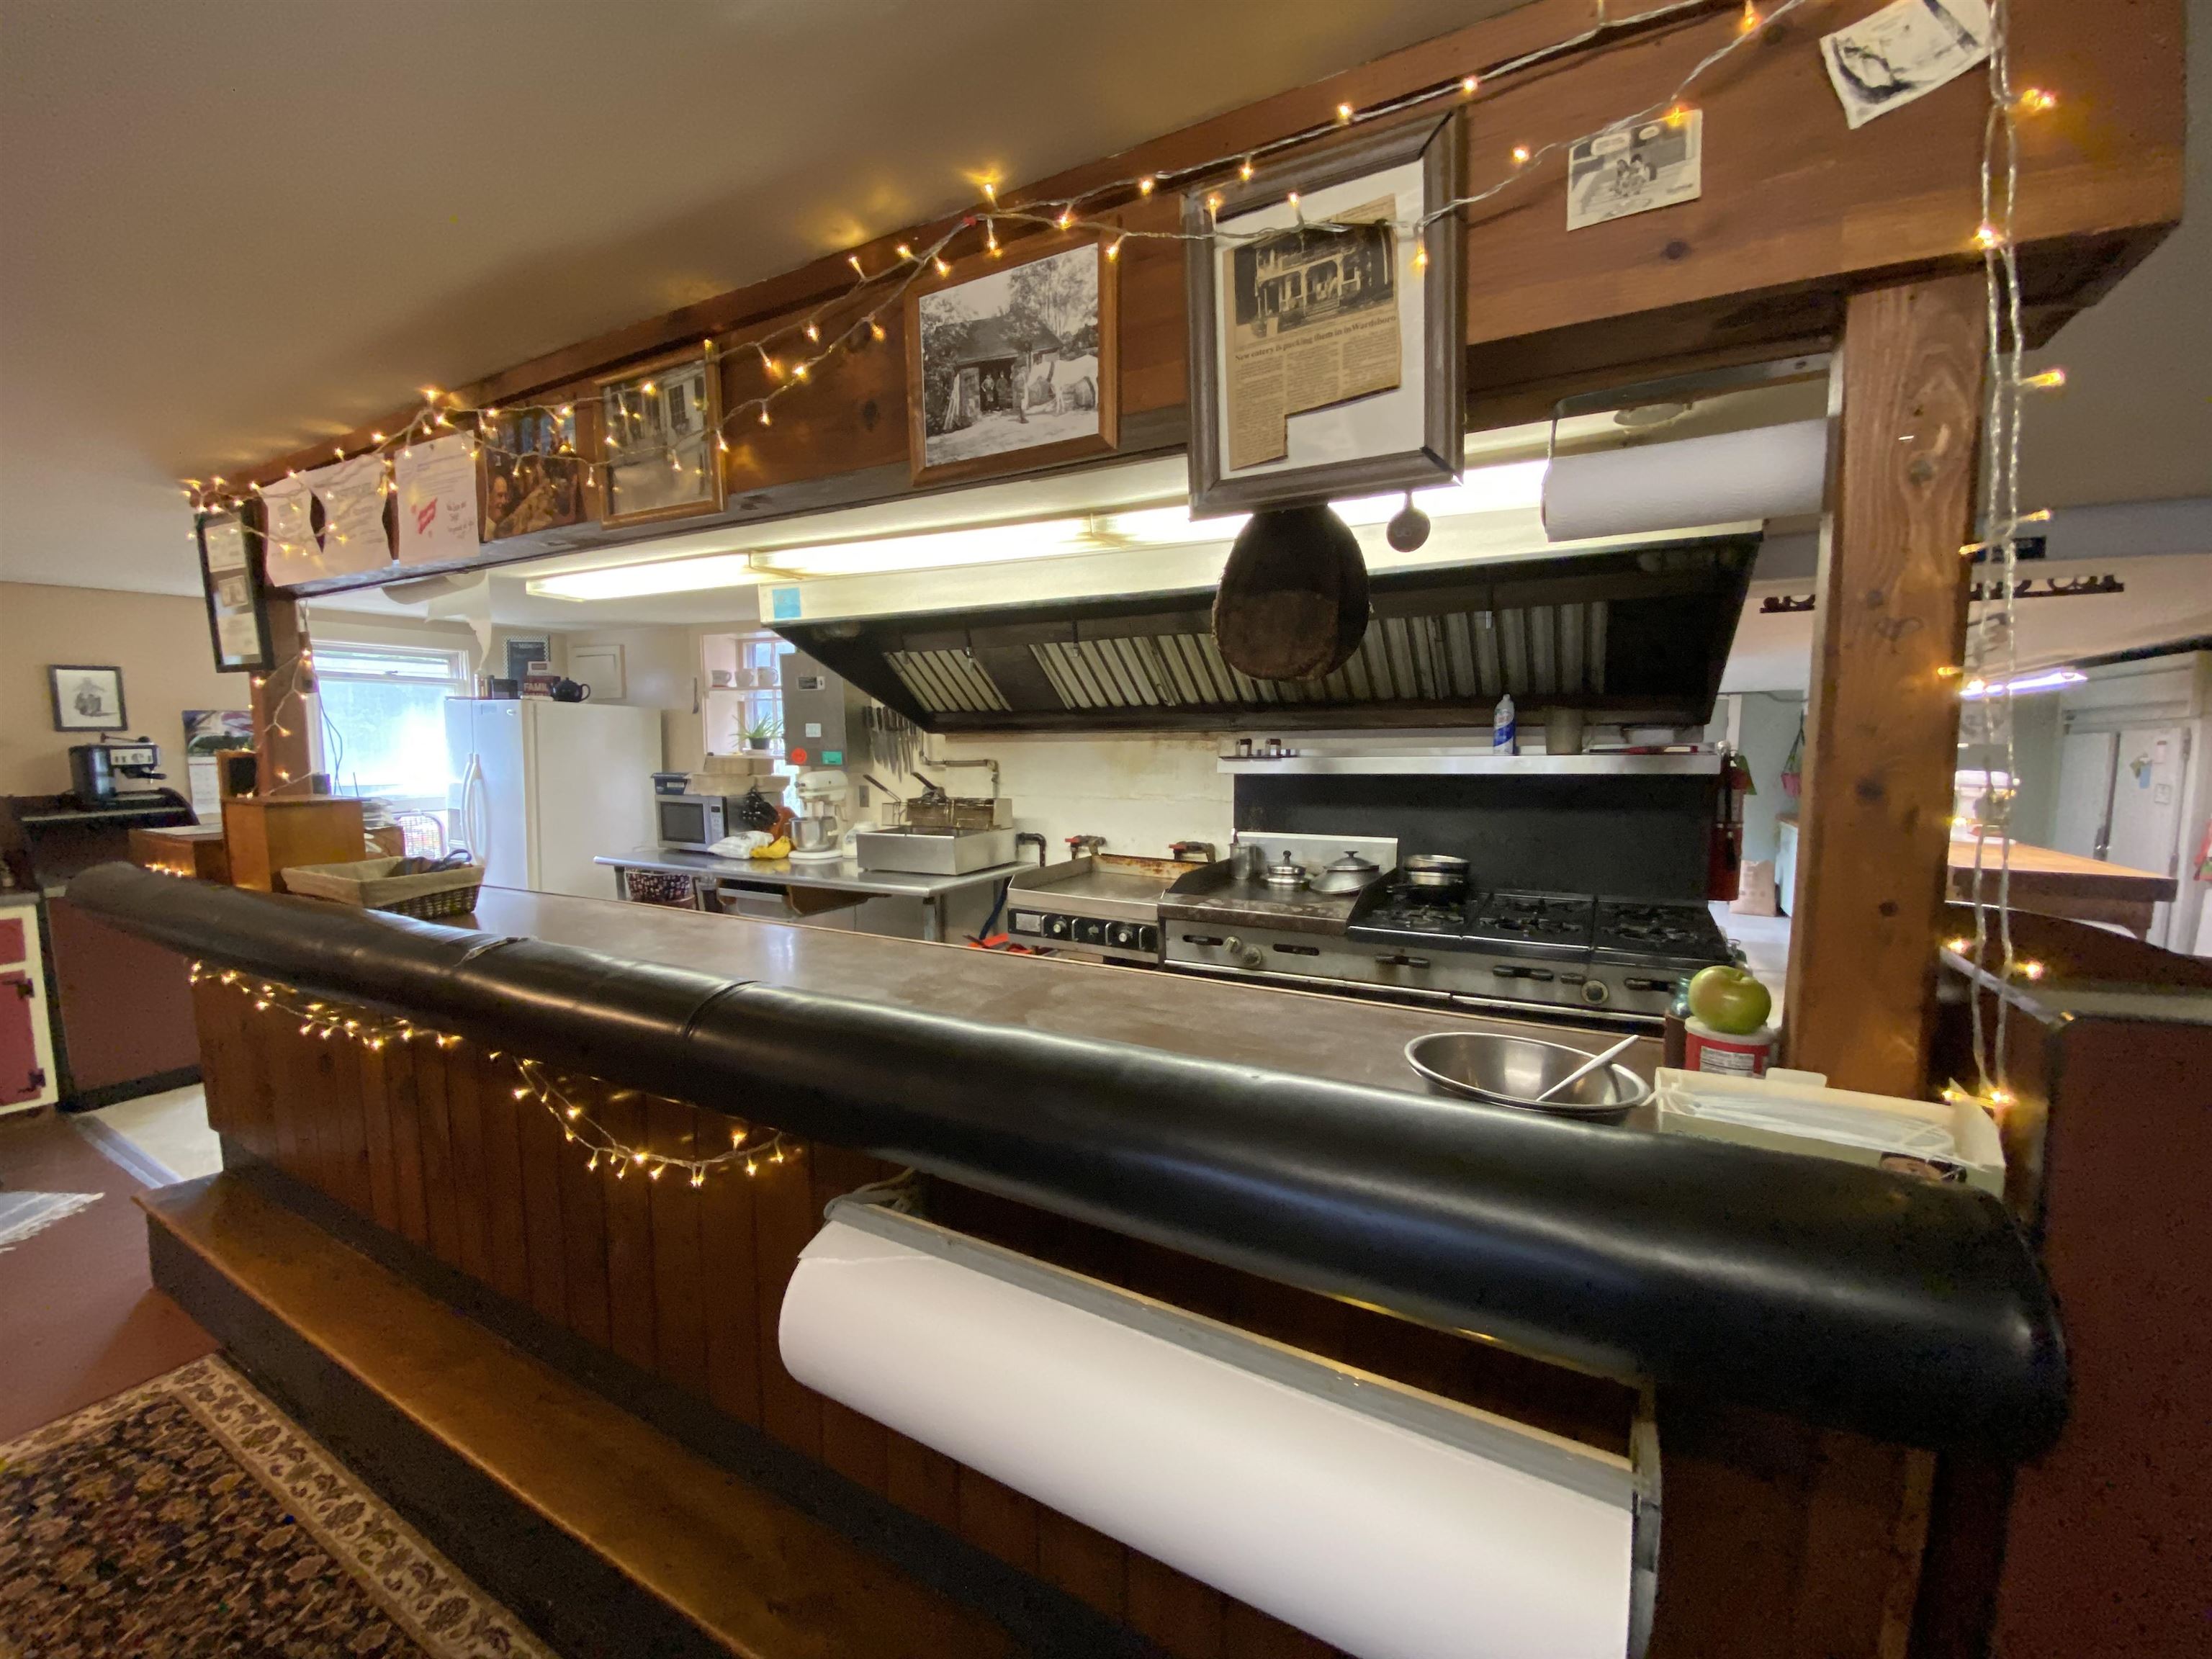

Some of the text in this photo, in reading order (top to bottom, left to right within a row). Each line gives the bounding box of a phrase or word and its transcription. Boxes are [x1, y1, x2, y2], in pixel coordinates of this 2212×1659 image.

[1314, 332, 1334, 341] them
[1352, 315, 1397, 331] Wardsboro
[523, 683, 552, 692] FAMIL
